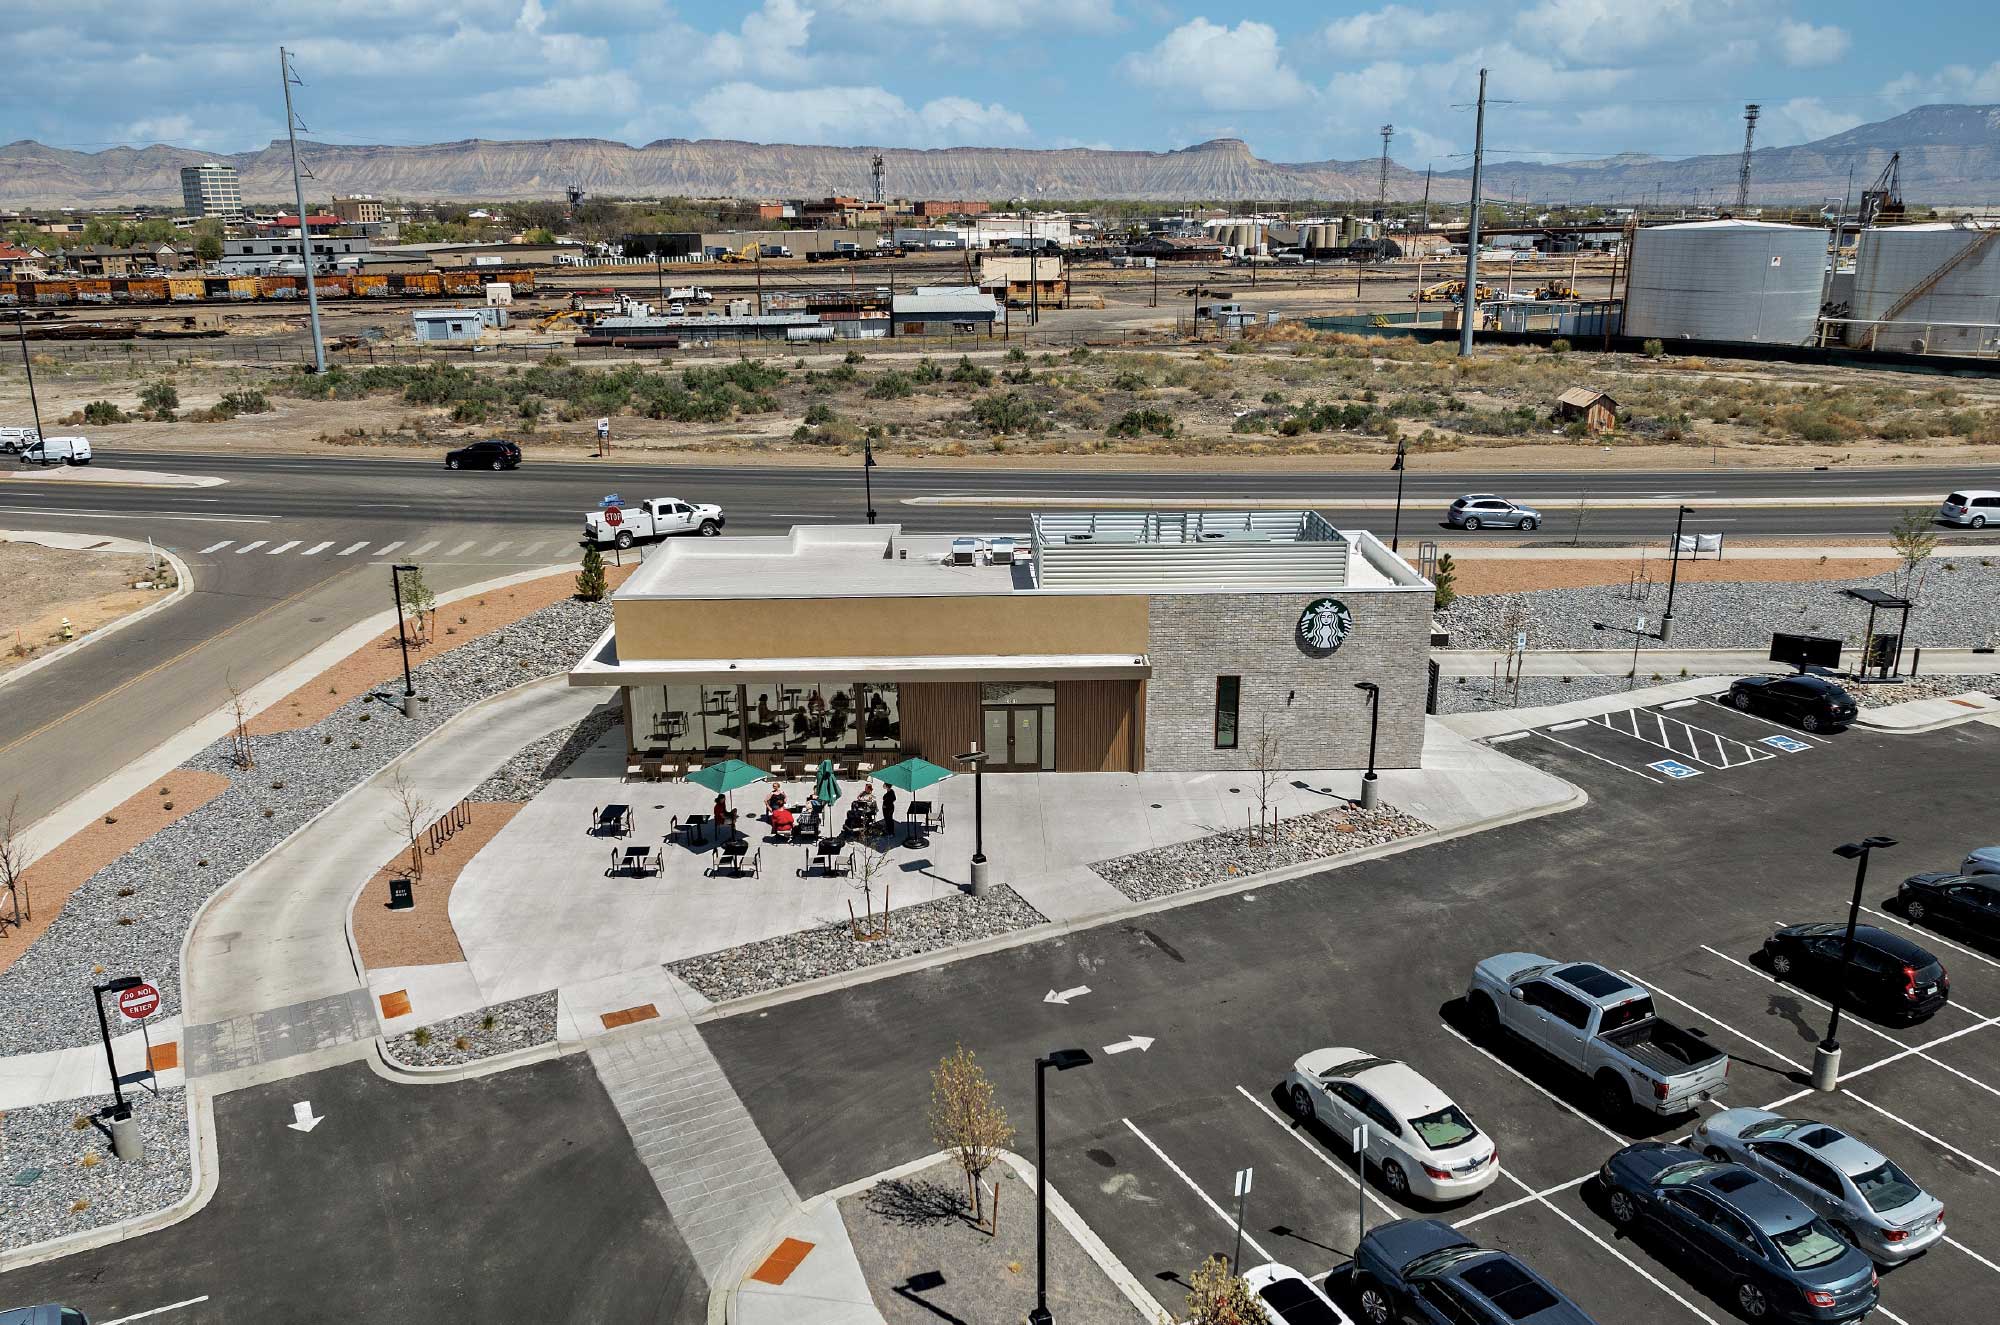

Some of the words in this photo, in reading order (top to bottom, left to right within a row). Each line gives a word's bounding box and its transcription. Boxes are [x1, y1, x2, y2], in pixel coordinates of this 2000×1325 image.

[606, 512, 621, 521] STOP
[124, 992, 134, 1000] DO
[137, 988, 151, 996] NOT
[129, 1004, 152, 1014] ENTER
